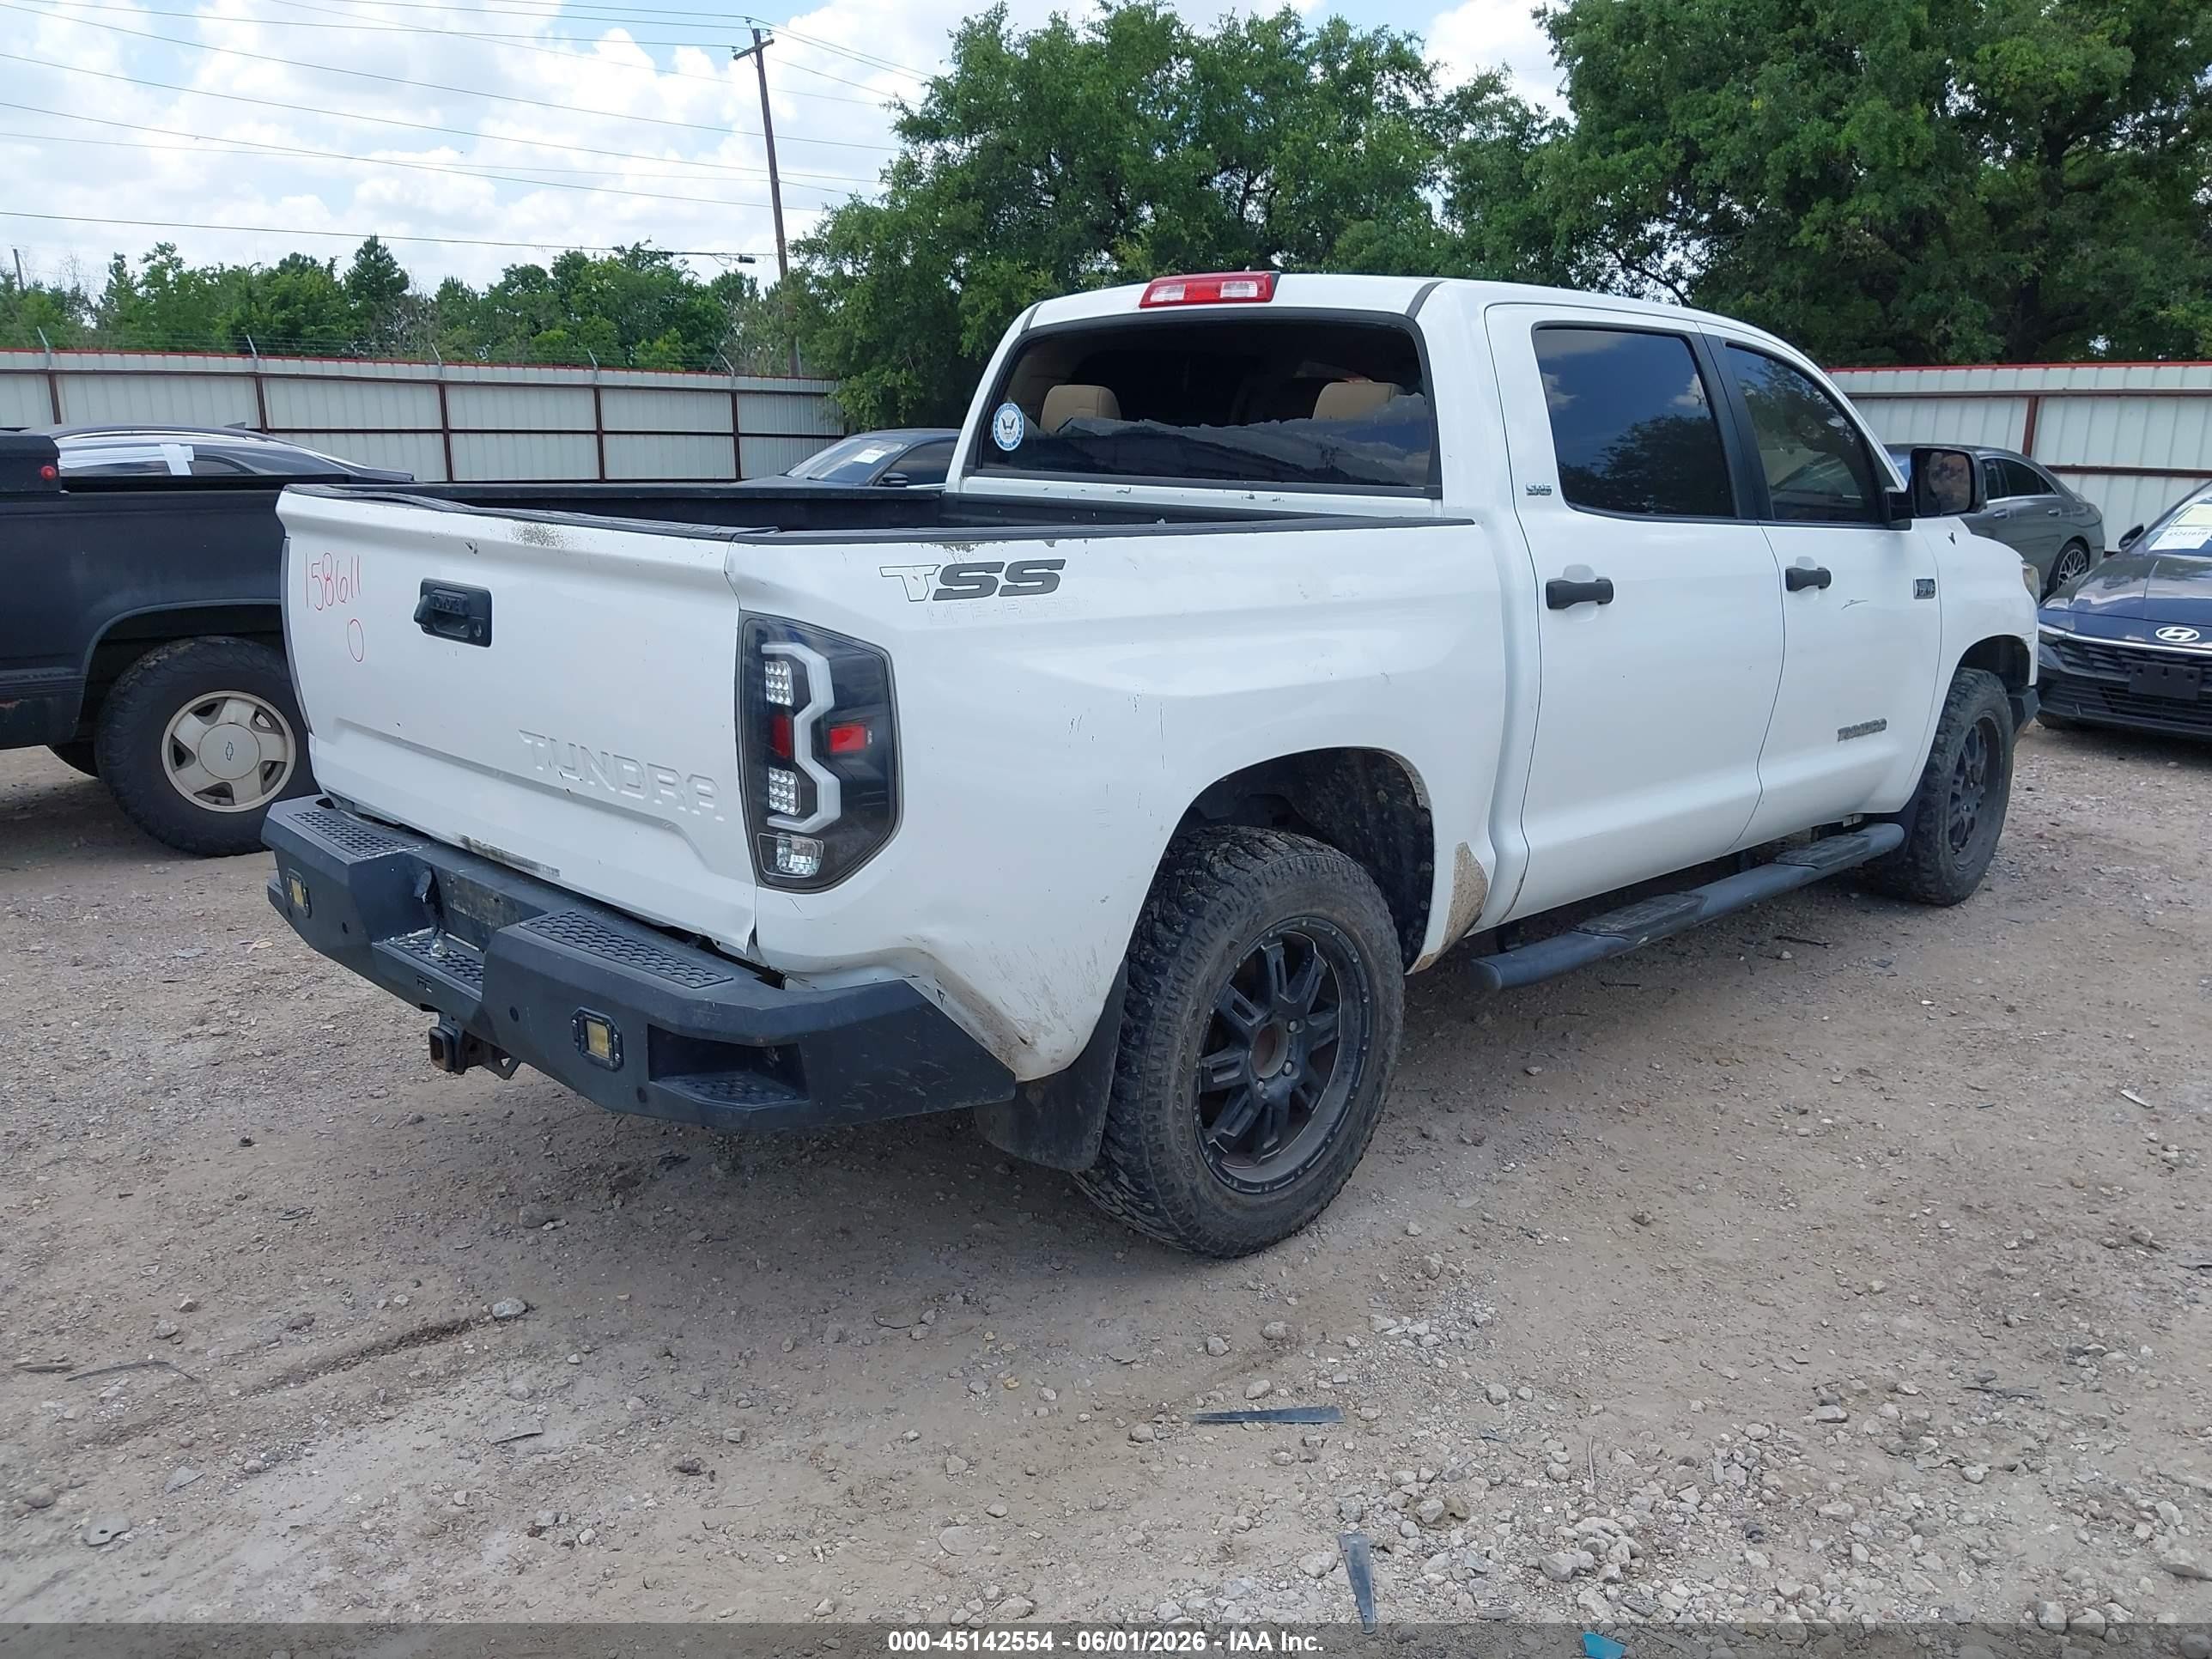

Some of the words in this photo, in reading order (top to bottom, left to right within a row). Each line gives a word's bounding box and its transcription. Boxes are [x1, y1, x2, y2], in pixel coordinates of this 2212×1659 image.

[305, 551, 362, 611] 158611
[878, 558, 1066, 603] TSS
[518, 729, 726, 822] TUNDRA
